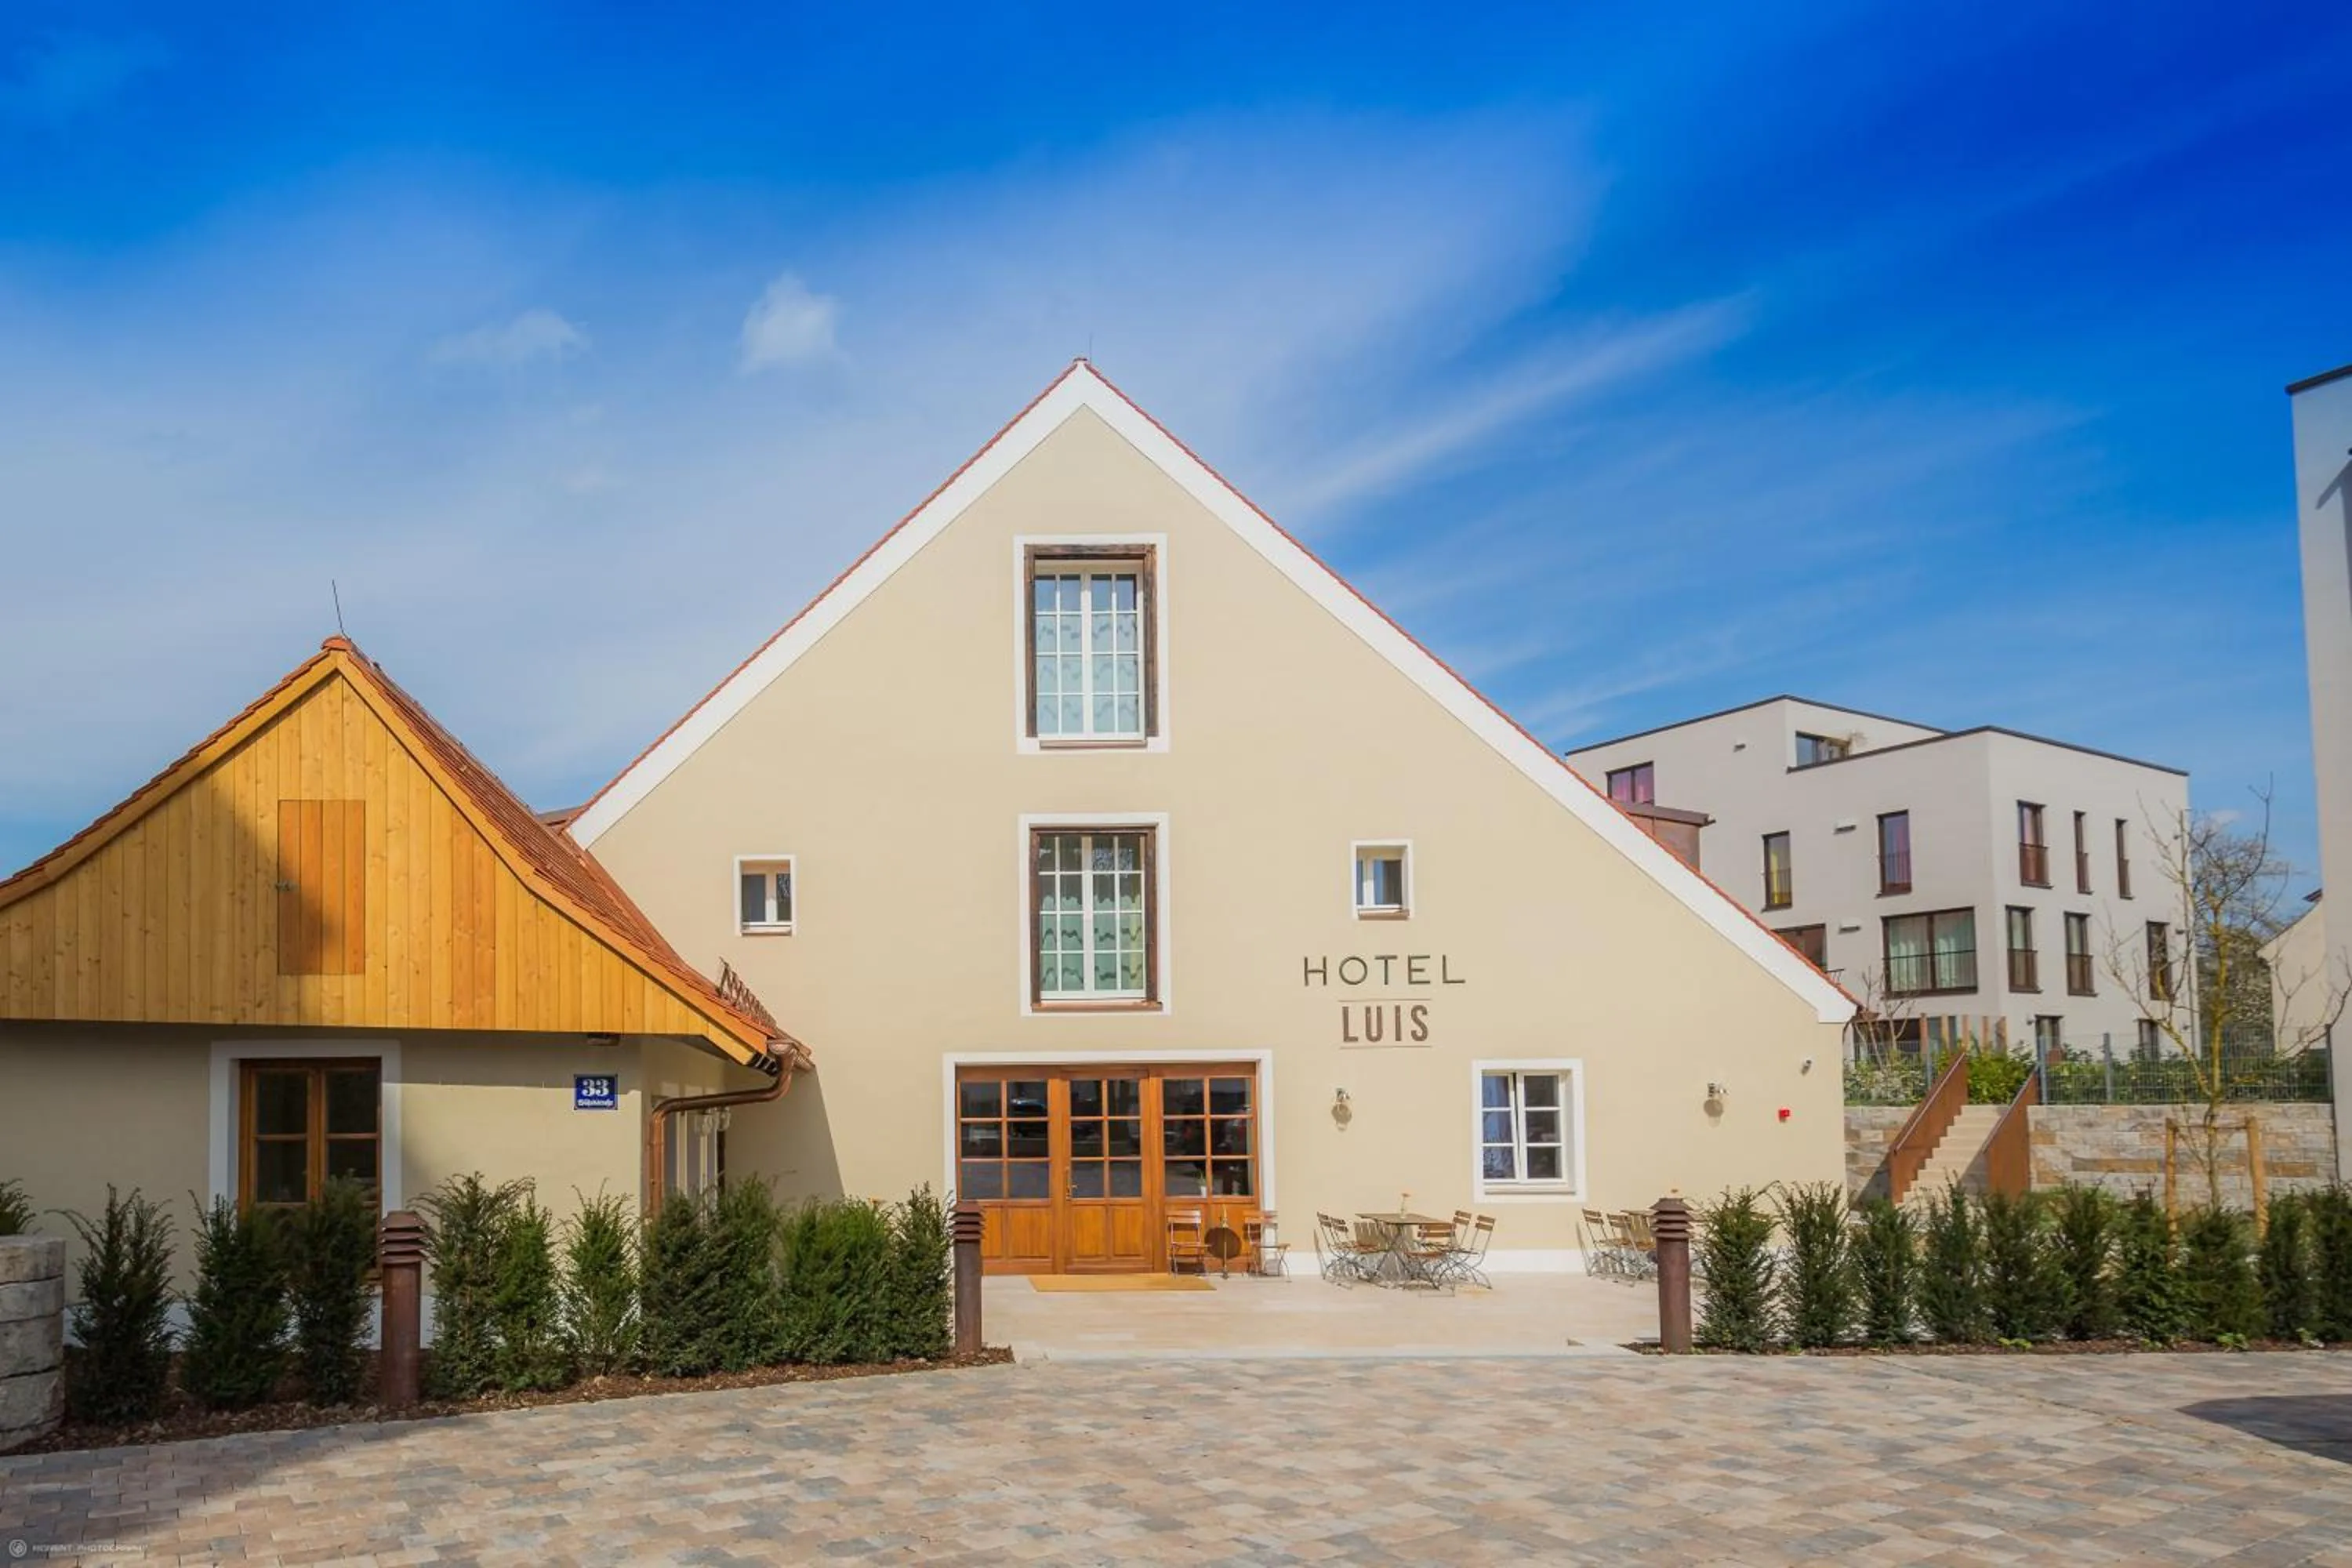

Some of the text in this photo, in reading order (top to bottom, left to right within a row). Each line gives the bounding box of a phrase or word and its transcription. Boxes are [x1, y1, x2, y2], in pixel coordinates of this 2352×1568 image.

[1304, 954, 1466, 986] HOTEL
[1342, 1005, 1428, 1042] LUIS
[582, 1078, 609, 1097] 33
